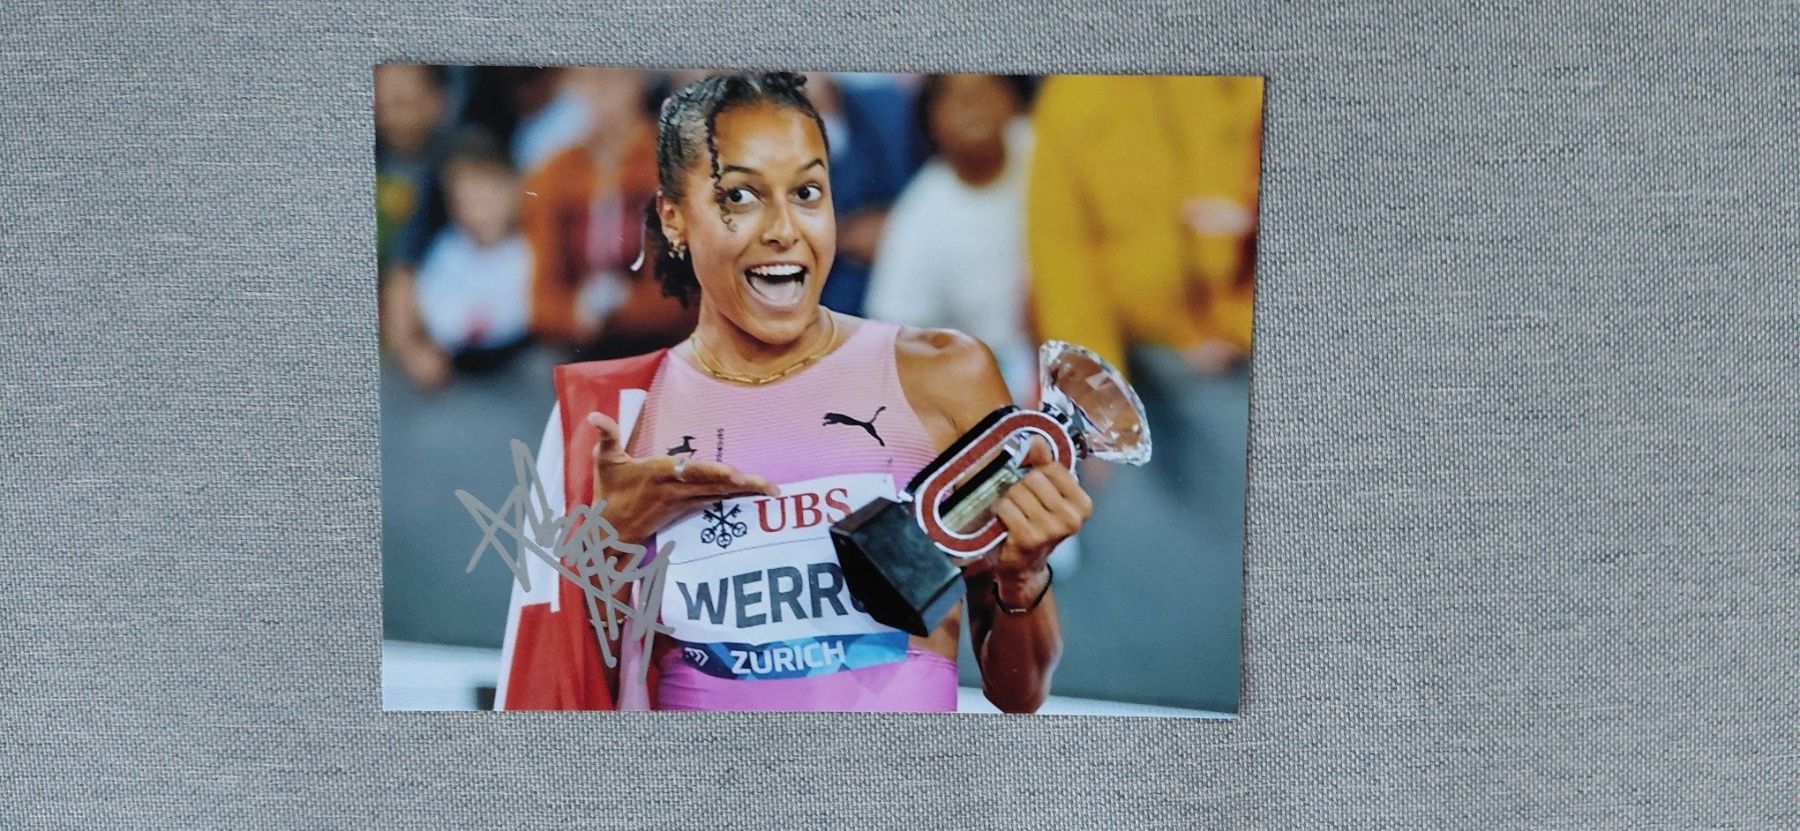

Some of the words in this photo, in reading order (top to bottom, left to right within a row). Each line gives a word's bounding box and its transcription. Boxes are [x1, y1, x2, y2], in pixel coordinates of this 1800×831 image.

[753, 487, 852, 533] UBS
[676, 562, 868, 628] WERR
[730, 640, 846, 675] ZURICH
